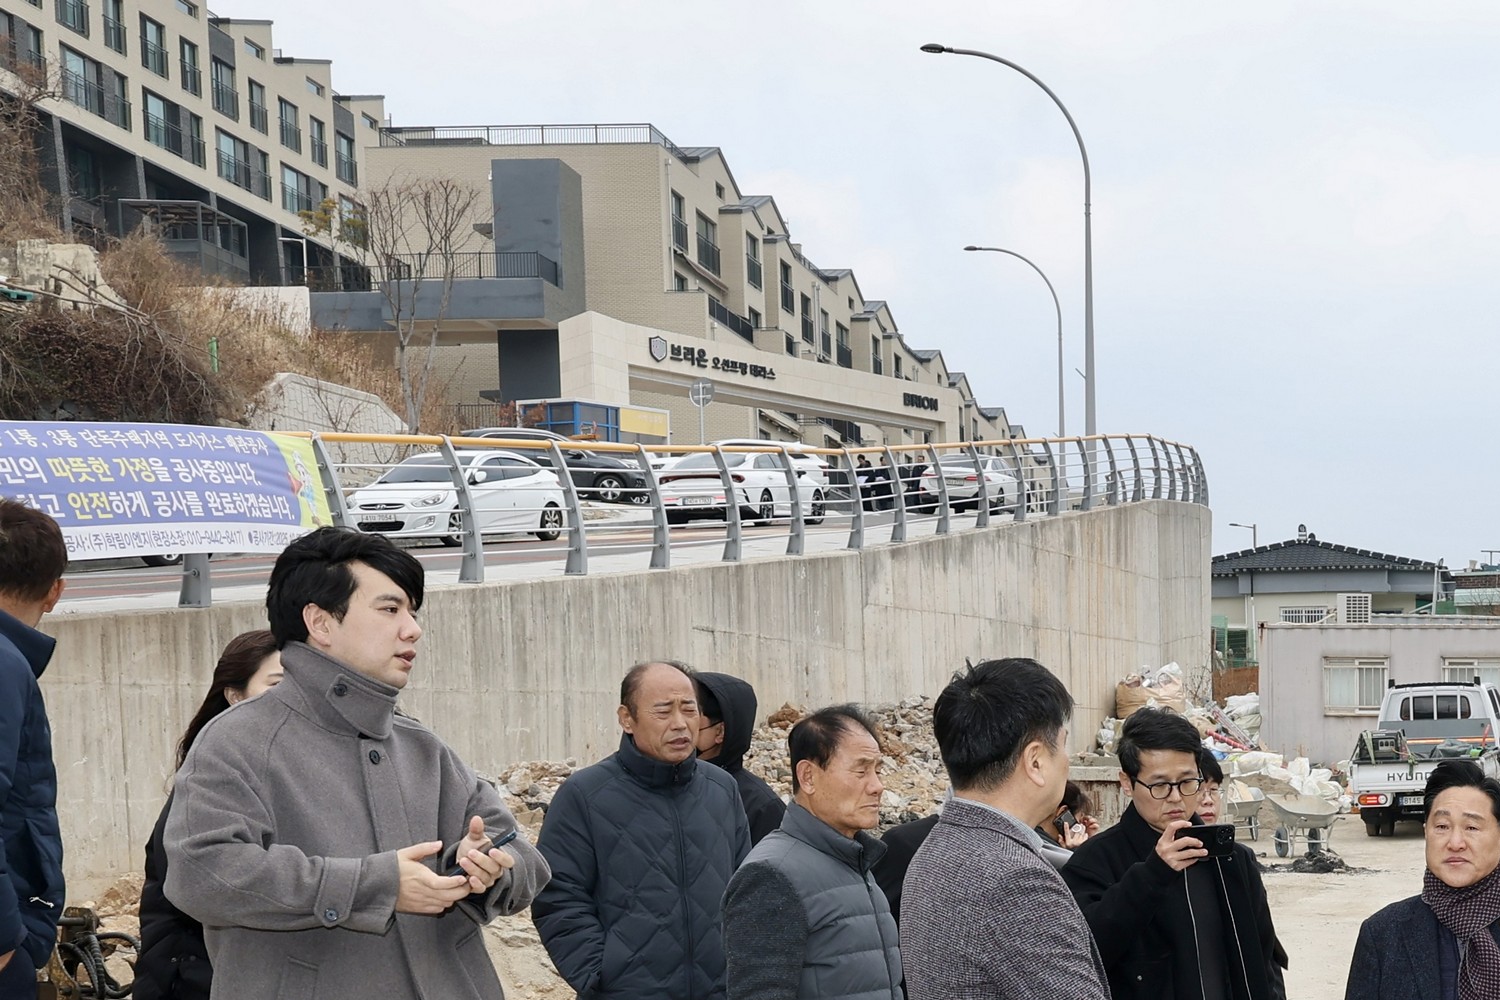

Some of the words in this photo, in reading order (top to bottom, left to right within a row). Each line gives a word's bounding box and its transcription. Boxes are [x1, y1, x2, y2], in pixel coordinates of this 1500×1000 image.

[669, 344, 709, 368] 브리온
[749, 364, 777, 380] 테라스
[903, 392, 939, 412] BRION
[46, 429, 79, 448] 3통
[77, 429, 174, 450] 단독주택지역
[171, 431, 226, 451] 도시가스
[223, 433, 270, 457] 배관공사
[0, 456, 48, 485] 민의
[46, 456, 116, 484] 따뜻한
[111, 457, 173, 483] 가정을
[169, 457, 263, 486] 공사중입니다.
[67, 490, 151, 520] 안전하게
[151, 490, 205, 518] 공사를
[204, 490, 296, 521] 완료하겠습니다.
